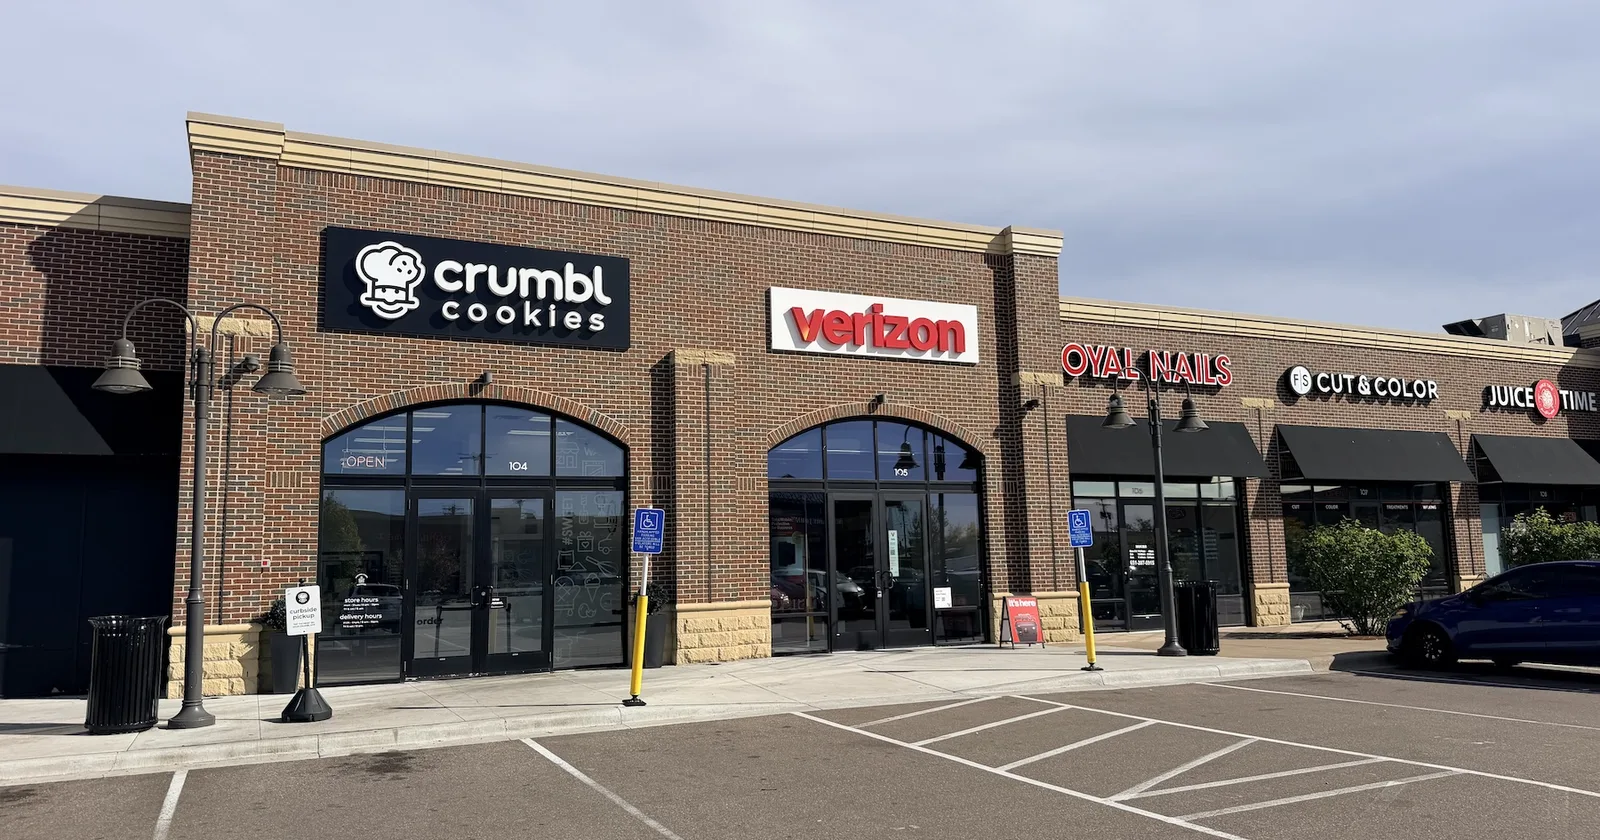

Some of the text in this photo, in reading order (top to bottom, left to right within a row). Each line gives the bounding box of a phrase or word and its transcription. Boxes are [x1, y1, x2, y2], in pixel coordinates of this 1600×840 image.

[433, 259, 612, 306] crumbl
[441, 300, 605, 332] cookies
[791, 303, 966, 353] verizon
[1061, 342, 1233, 387] OYAL NAILS
[1489, 385, 1598, 412] JUICE TIME
[346, 455, 385, 468] OPEN
[508, 461, 528, 471] 104
[893, 468, 909, 477] 105
[1019, 599, 1036, 607] here
[292, 613, 315, 621] pickup
[416, 617, 443, 625] order
